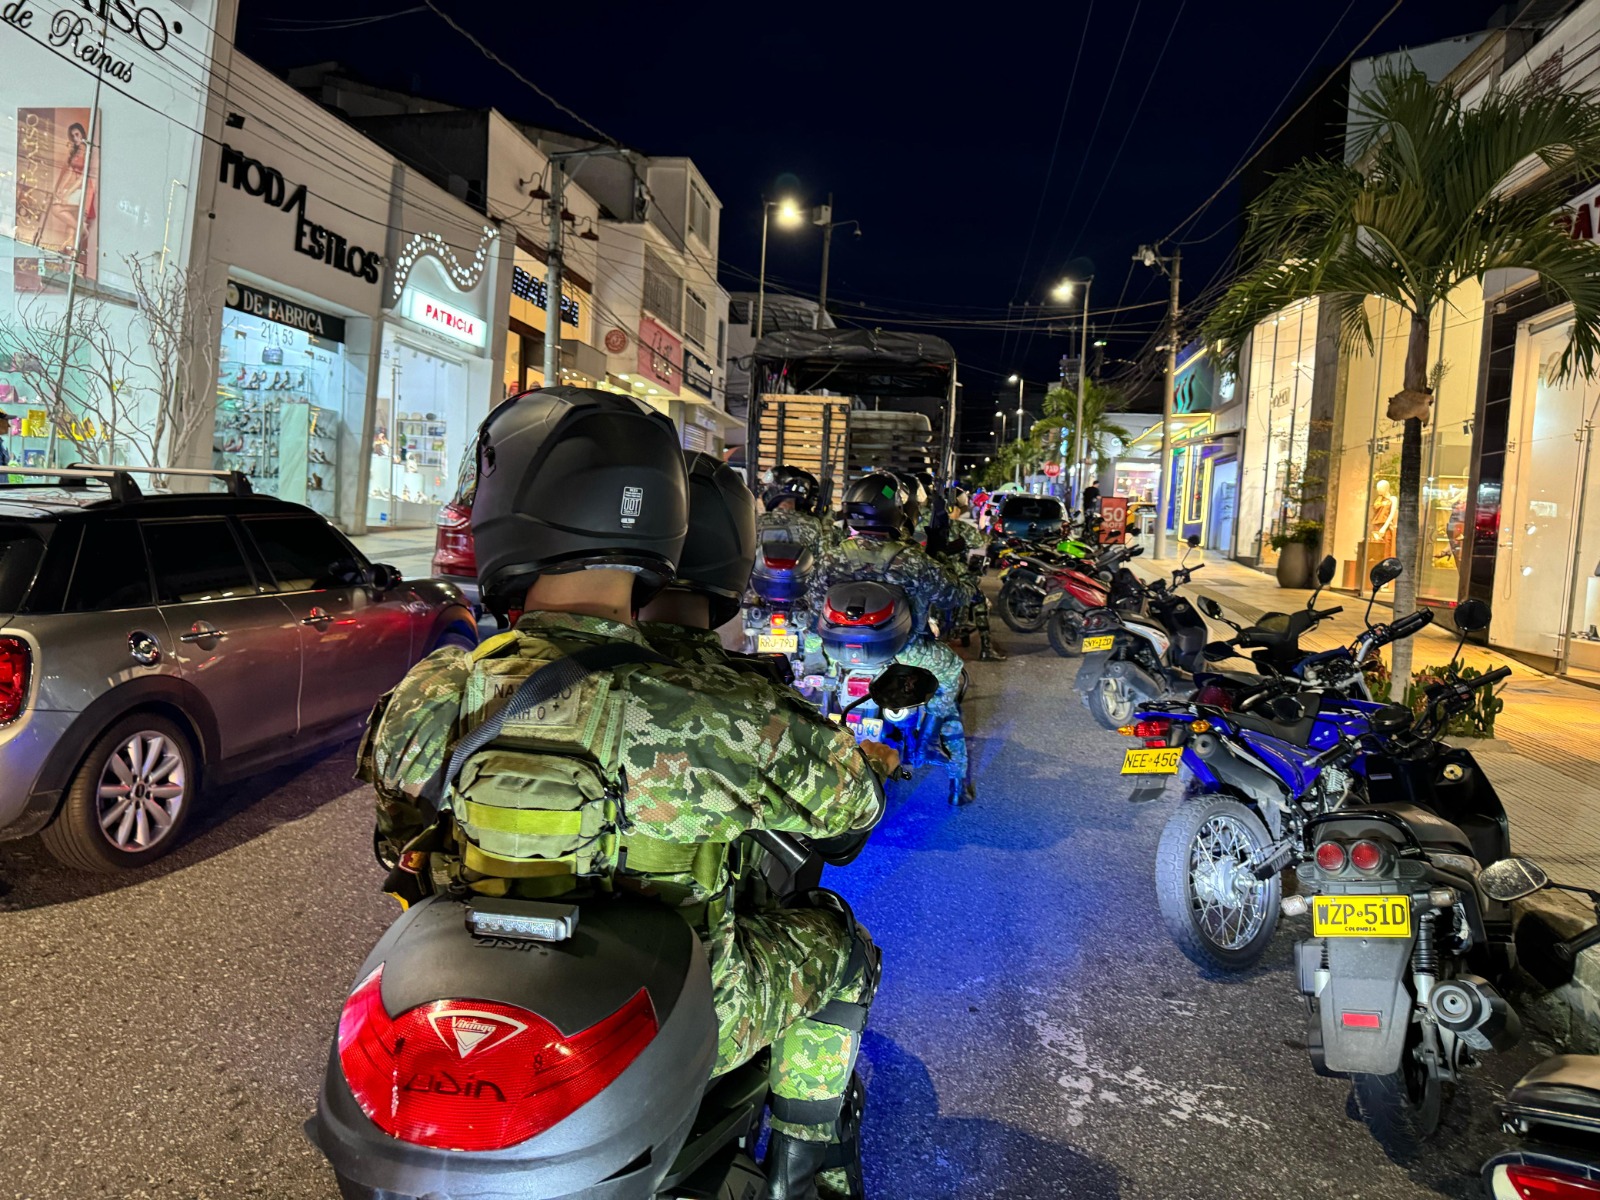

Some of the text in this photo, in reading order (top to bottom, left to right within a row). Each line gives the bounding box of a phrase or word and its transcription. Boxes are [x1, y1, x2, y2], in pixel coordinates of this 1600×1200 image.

[49, 9, 135, 84] Reinas
[294, 214, 380, 285] ESTILOS
[243, 290, 325, 336] DE FABRICA
[425, 303, 475, 336] PATRICIA
[282, 328, 294, 347] 53
[1102, 507, 1126, 523] 50
[451, 1016, 497, 1033] Vikingo
